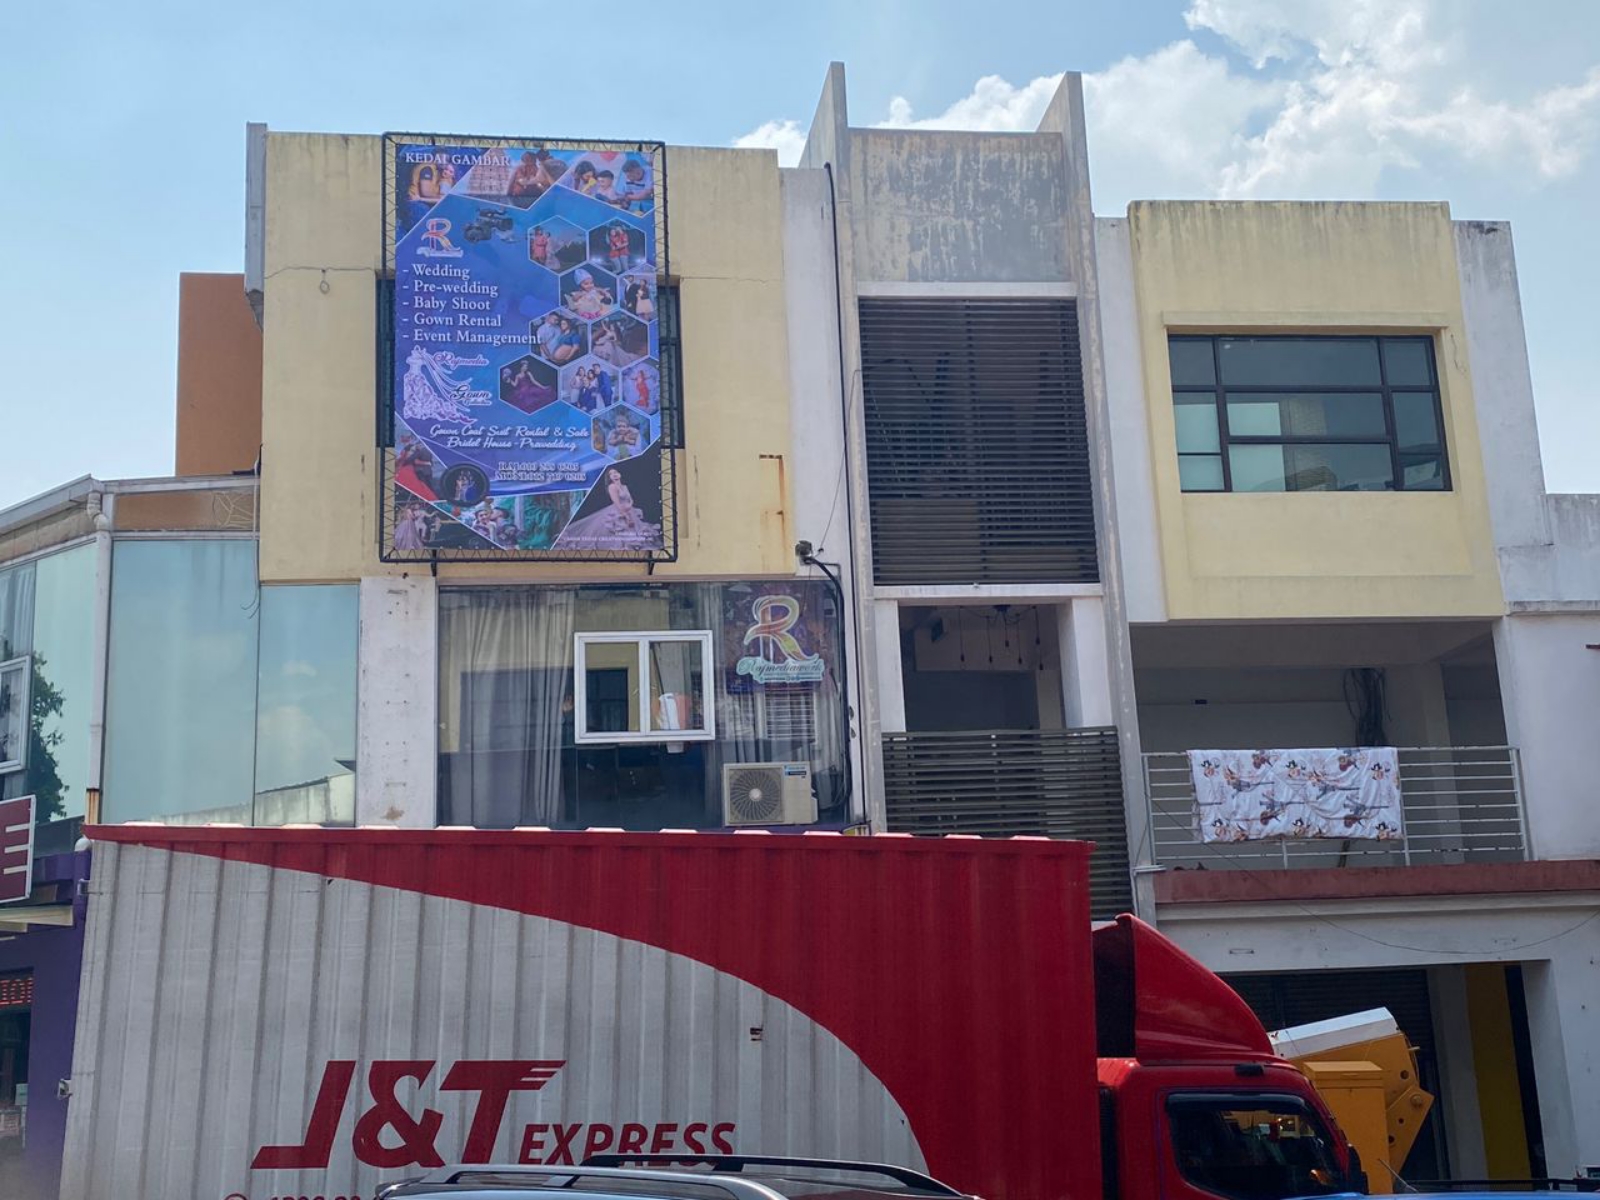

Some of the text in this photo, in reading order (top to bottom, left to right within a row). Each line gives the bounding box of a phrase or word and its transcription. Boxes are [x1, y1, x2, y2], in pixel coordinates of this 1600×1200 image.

[405, 153, 511, 166] KEDAI GAMBAR
[412, 264, 470, 280] Wedding
[414, 280, 499, 298] Pre-wedding
[414, 296, 447, 312] Baby
[452, 297, 491, 311] Shoot
[414, 312, 454, 326] Gown
[458, 313, 502, 327] Rental
[414, 329, 451, 342] Event
[456, 330, 542, 347] Management
[516, 425, 550, 437] Rental
[554, 427, 563, 437] &
[565, 426, 590, 438] Sale
[250, 1060, 736, 1169] J&T EXPRESS
